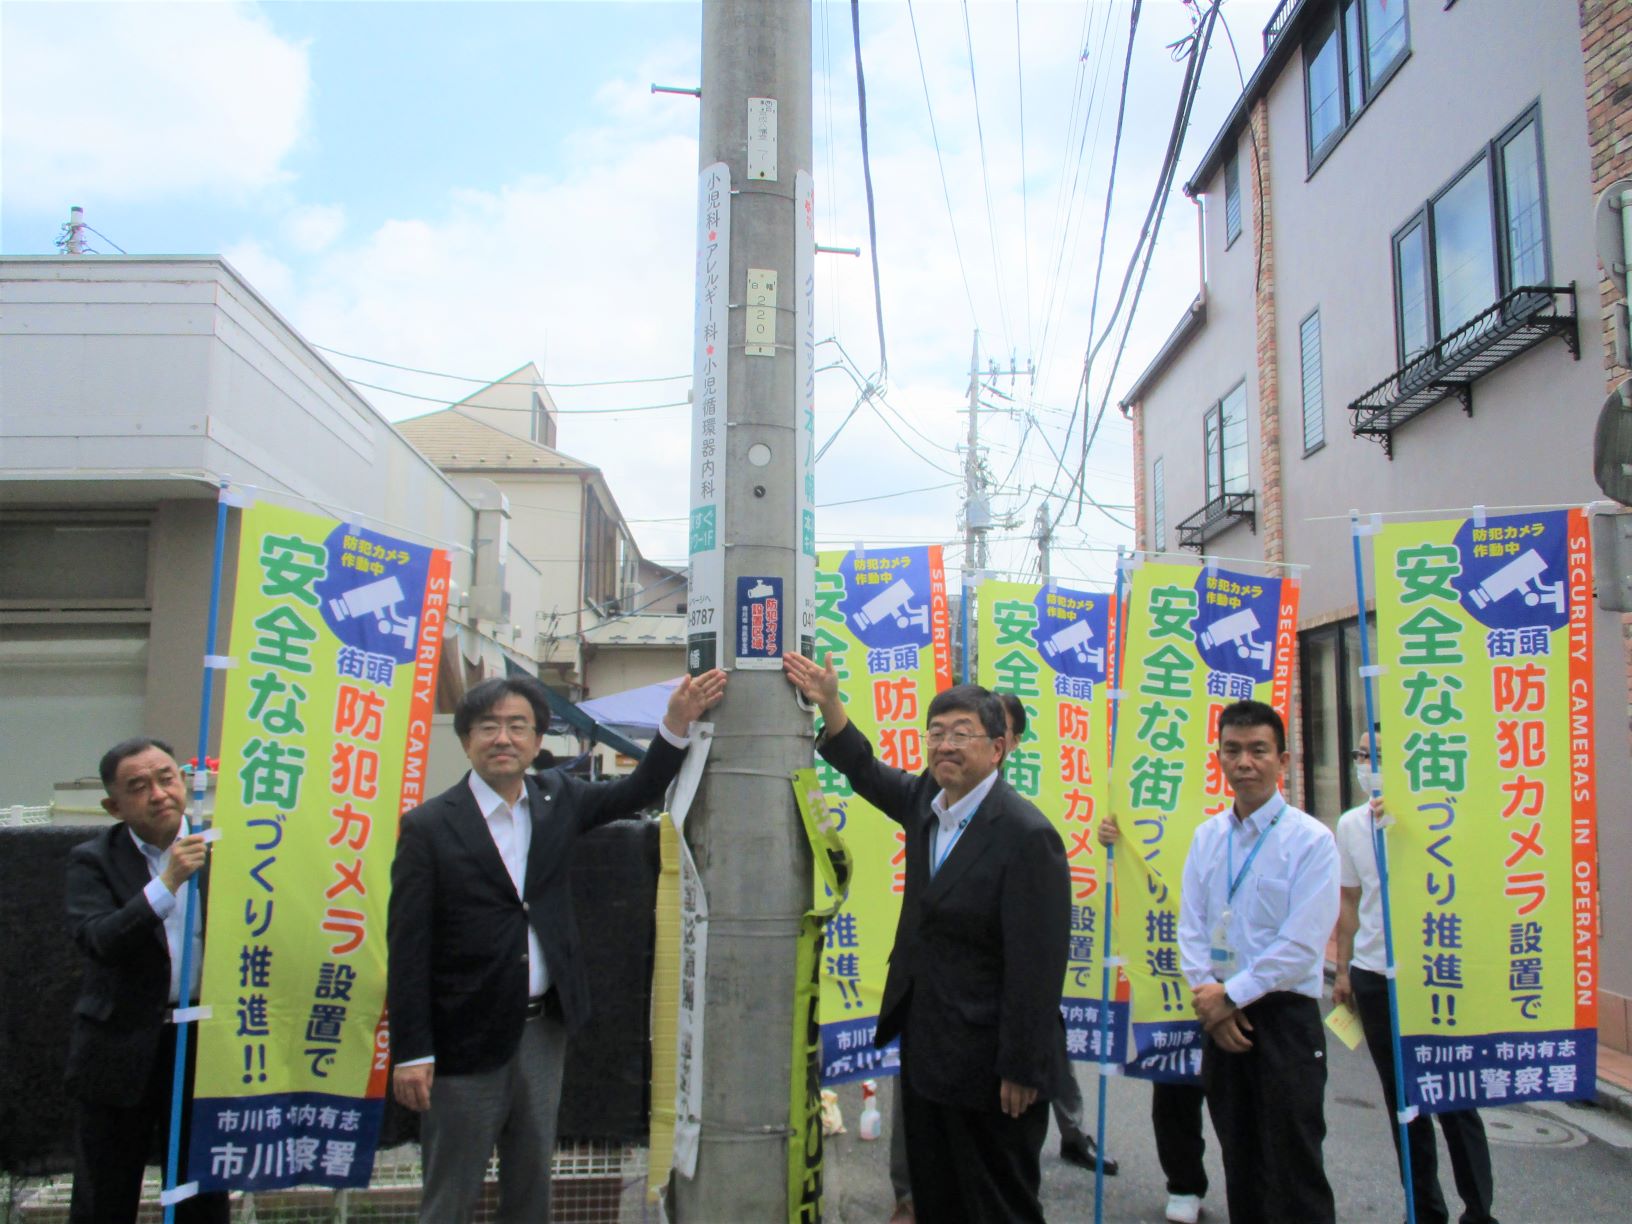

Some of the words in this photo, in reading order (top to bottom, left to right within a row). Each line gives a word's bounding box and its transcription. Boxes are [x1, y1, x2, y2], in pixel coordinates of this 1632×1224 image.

[706, 172, 721, 230] 小児科
[704, 243, 719, 343] アレルギー科
[700, 357, 717, 500] 小児循環器内科
[1473, 523, 1545, 542] 防犯カメラ
[341, 553, 385, 576] 作動中
[343, 534, 410, 565] 防犯カメラ
[854, 556, 911, 571] 防犯カメラ
[1473, 541, 1520, 558] 作動中
[856, 572, 893, 585] 作動中
[1206, 576, 1263, 599] 防犯カメラ
[1046, 593, 1095, 612] 防犯カメラ
[1046, 606, 1077, 622] 作動中
[1206, 593, 1242, 609] 作動中
[1570, 536, 1587, 662] SECURITY
[766, 598, 778, 656] 防犯カメラ
[932, 568, 949, 679] SECURITY
[414, 576, 445, 703] SECURITY
[1487, 627, 1550, 658] 街頭
[337, 647, 395, 687] 街頭
[867, 644, 918, 674] 街頭
[1273, 604, 1293, 715] SECURITY
[1055, 674, 1093, 701] 街頭
[1207, 671, 1254, 702] 街頭
[1571, 679, 1590, 802] CAMERAS
[402, 720, 426, 813] CAMER
[1575, 819, 1590, 845] IN
[1575, 861, 1592, 1006] OPERATION
[1414, 1039, 1577, 1064] 市川市・市内有志
[1416, 1064, 1577, 1105] 市川警察署
